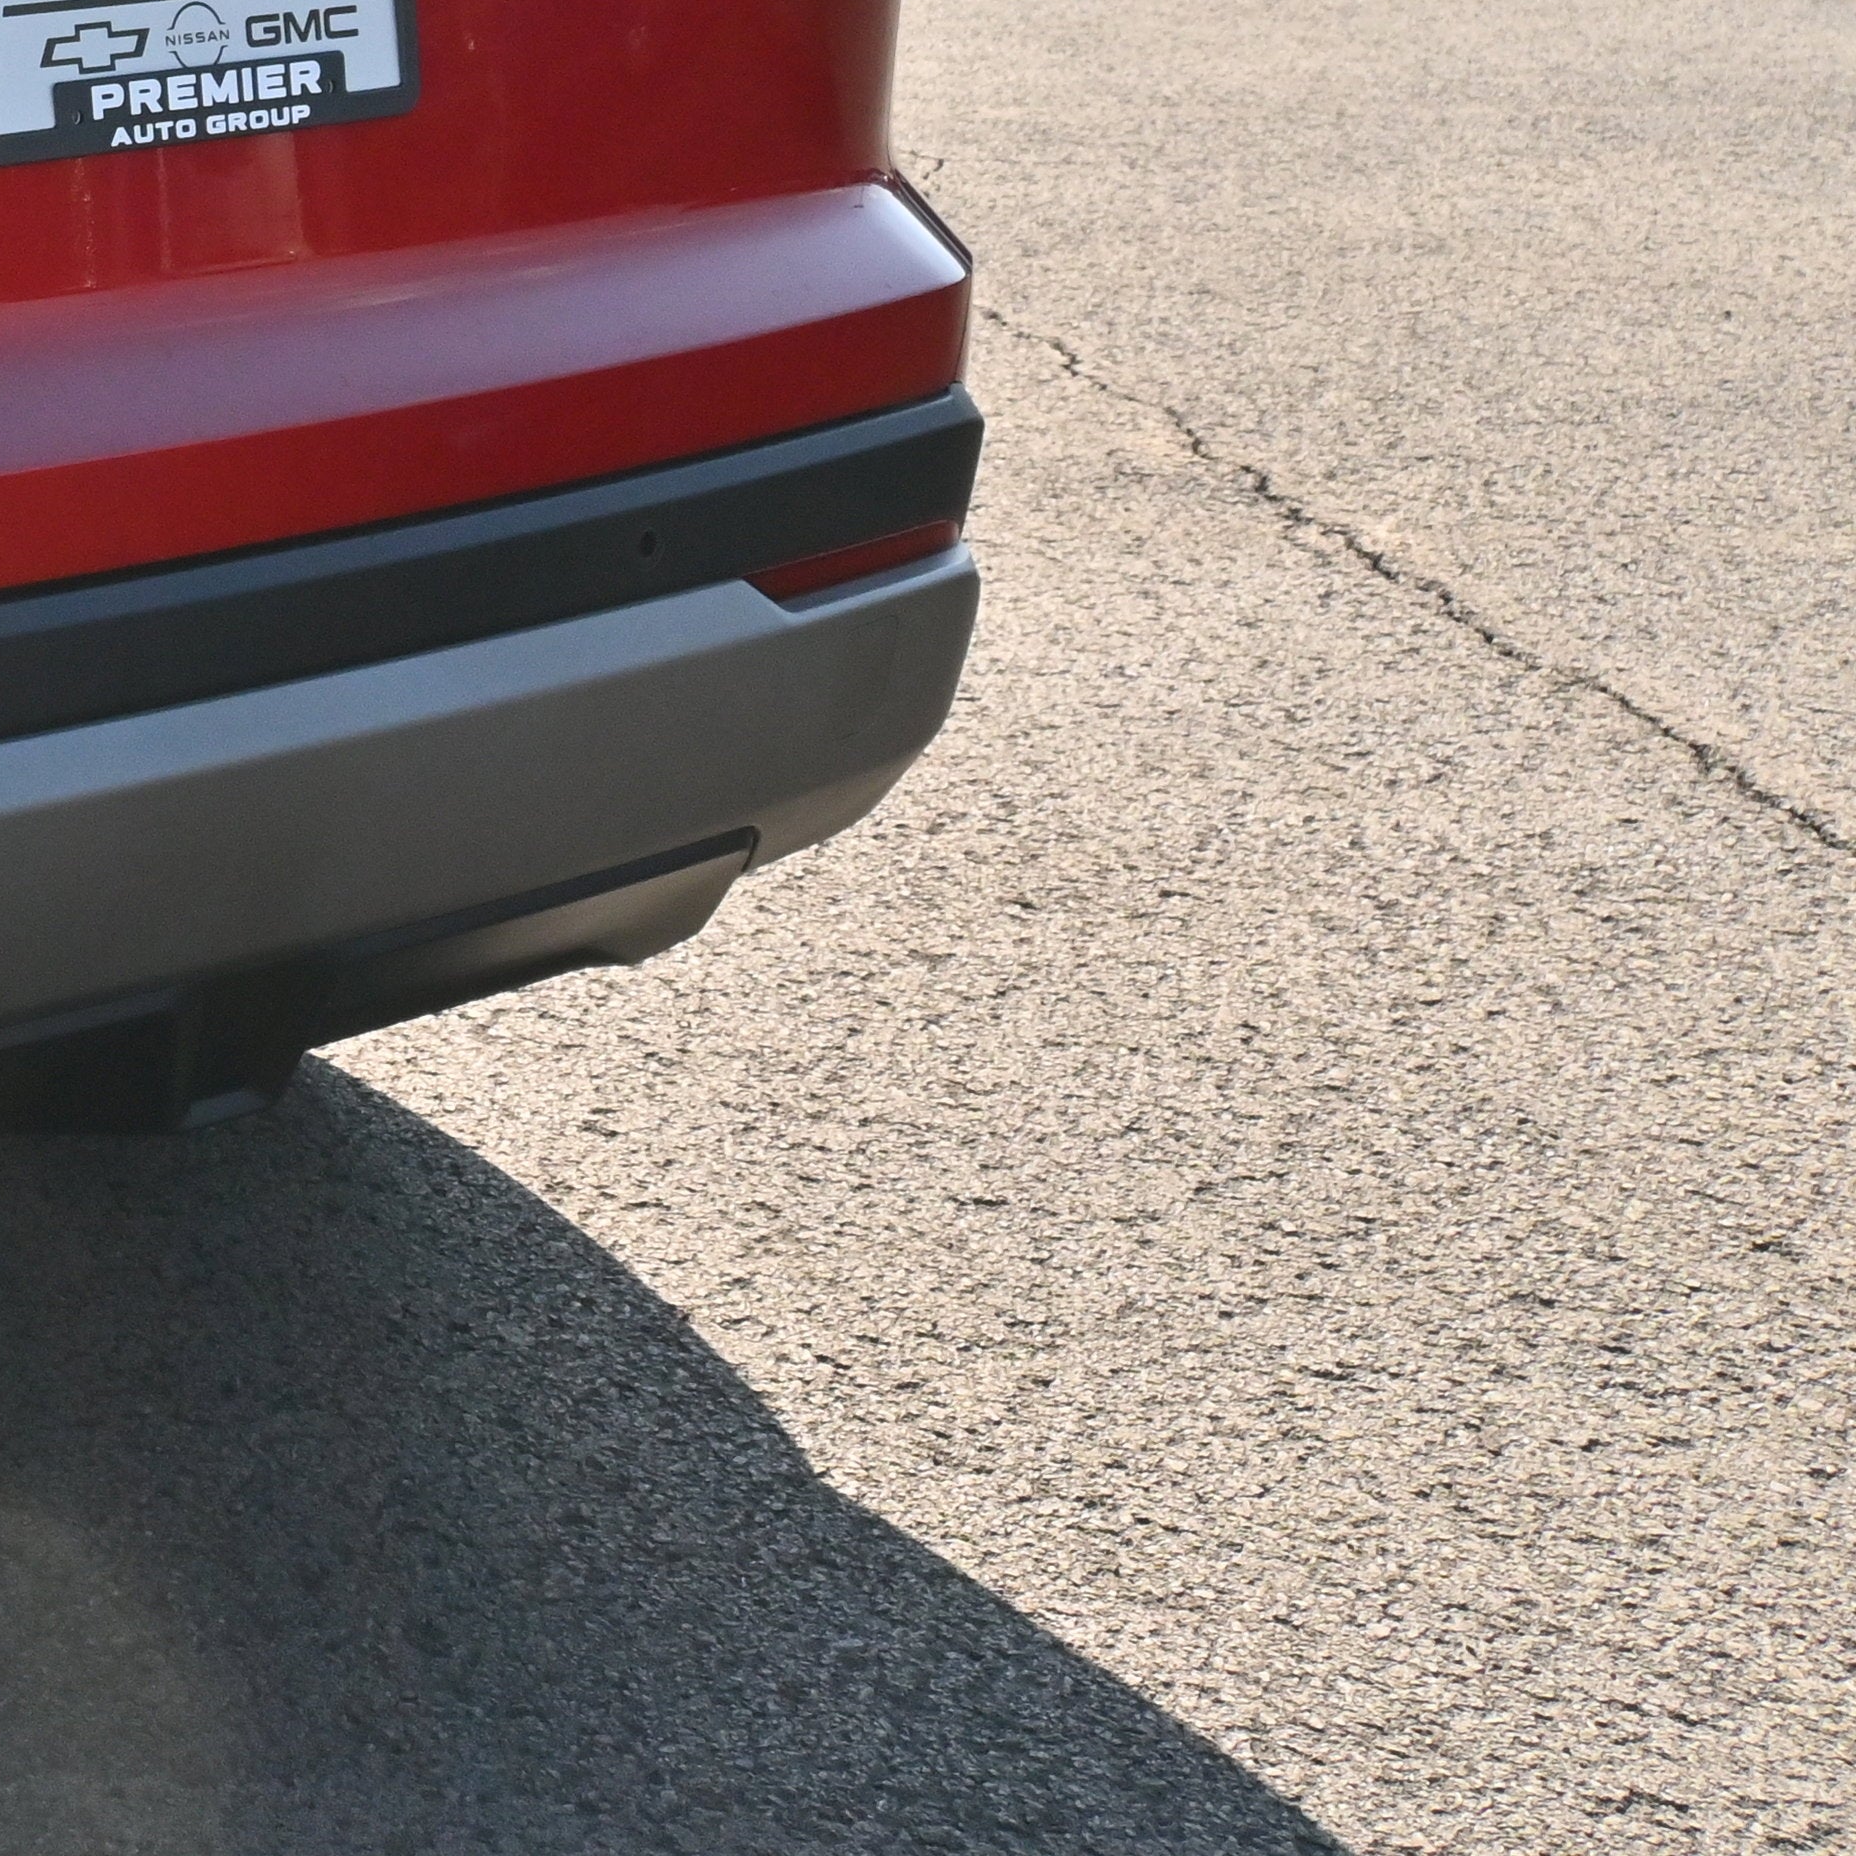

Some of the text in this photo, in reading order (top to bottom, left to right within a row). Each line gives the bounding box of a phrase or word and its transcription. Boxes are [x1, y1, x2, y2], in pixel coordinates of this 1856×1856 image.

[165, 29, 230, 47] NISSAN
[245, 5, 359, 47] GMC
[91, 59, 323, 121] PREMIER
[110, 104, 311, 147] AUTO GROUP
